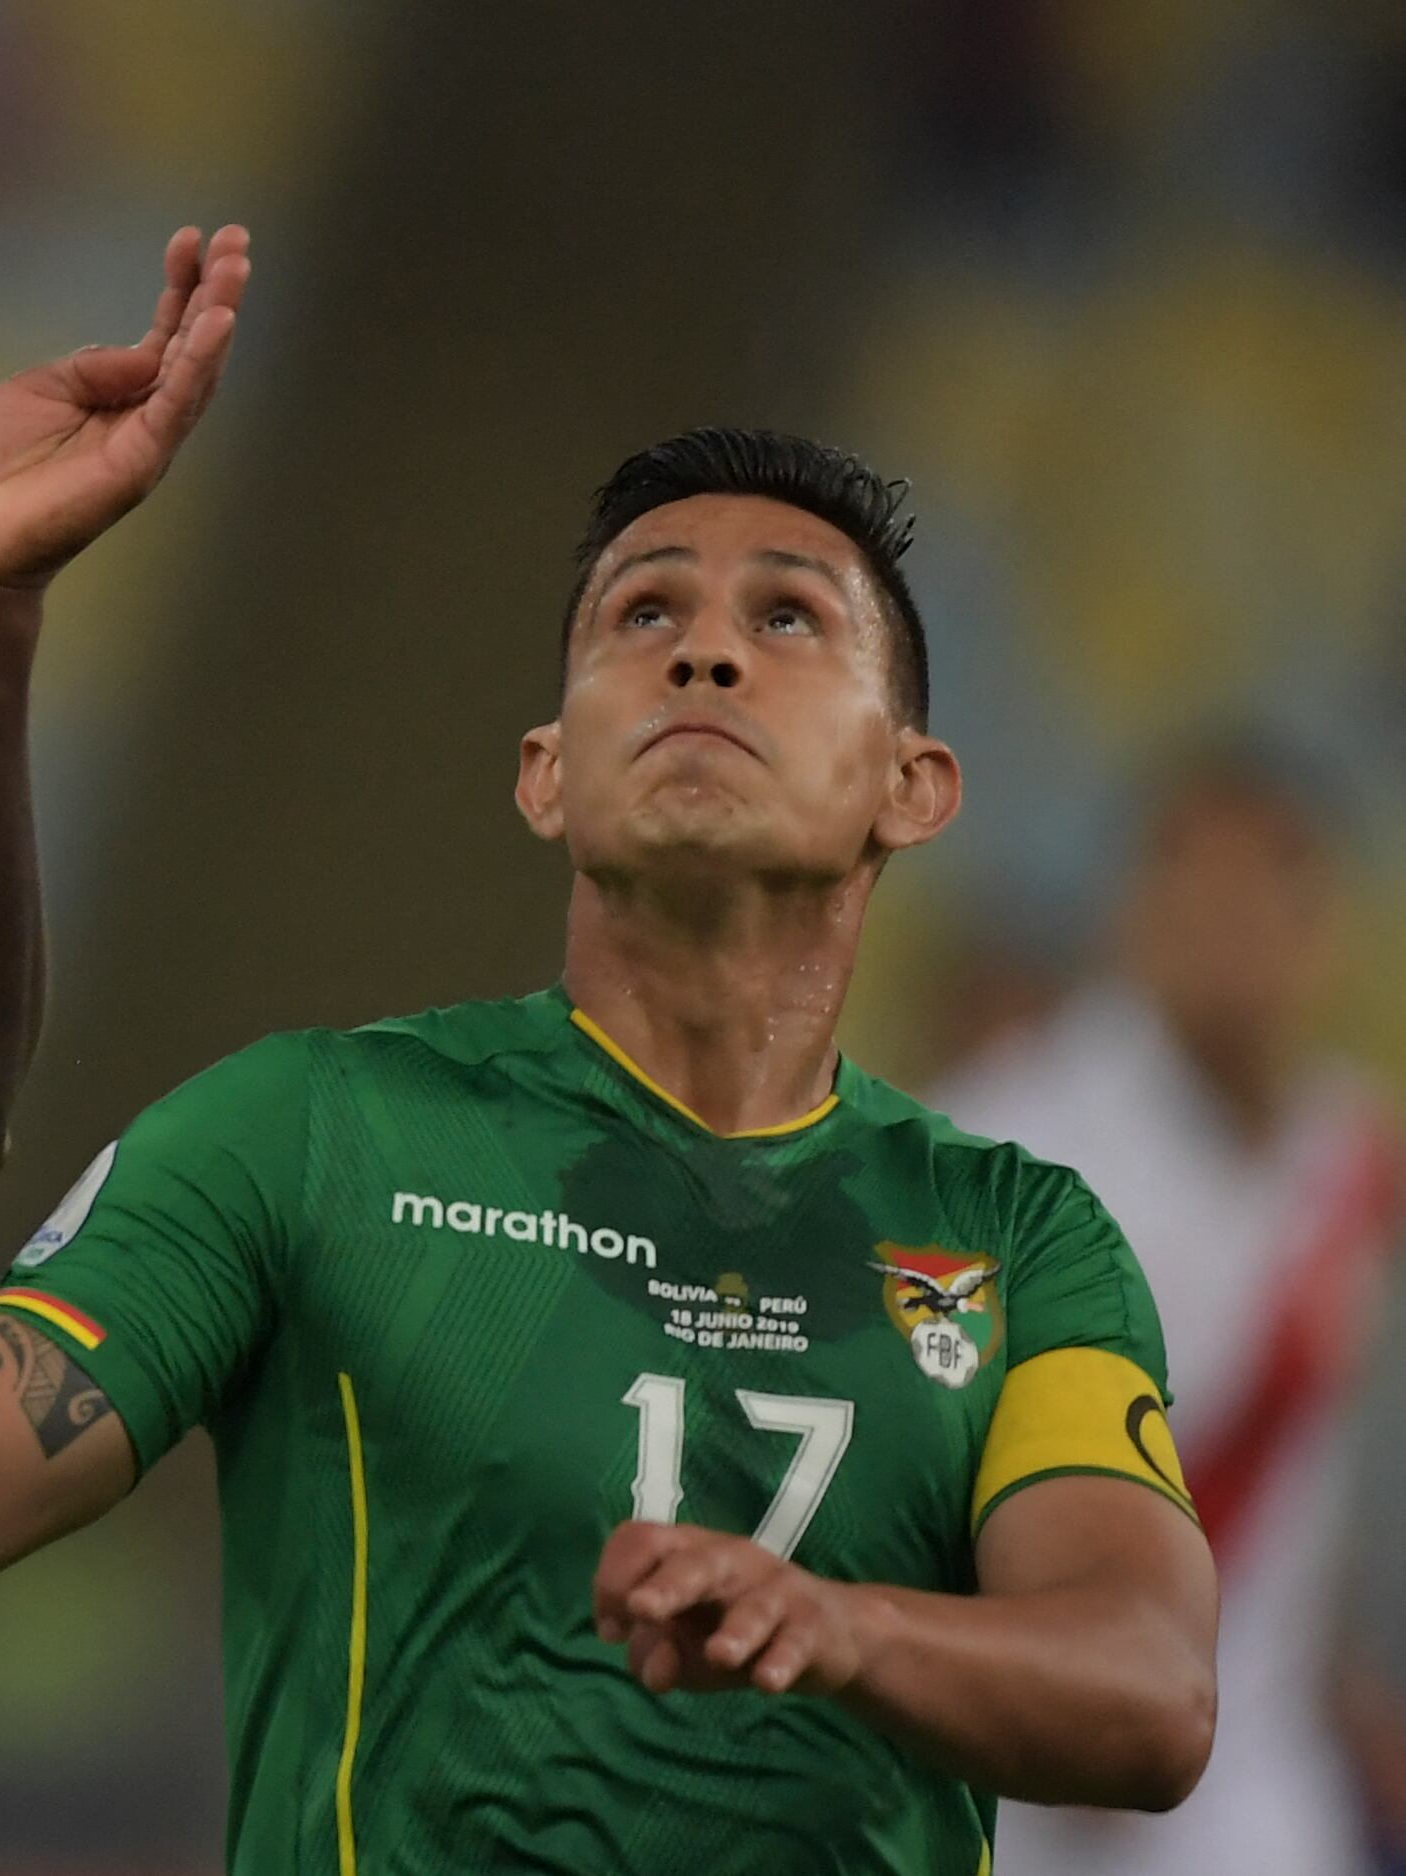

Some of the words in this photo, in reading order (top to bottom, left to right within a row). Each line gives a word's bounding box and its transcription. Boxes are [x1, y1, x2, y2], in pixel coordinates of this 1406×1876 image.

[392, 1191, 657, 1269] marathon
[648, 1279, 718, 1303] BOLIVIA
[759, 1295, 808, 1314] PERÚ
[670, 1309, 693, 1327] 18
[695, 1312, 754, 1329] JUNIO
[697, 1330, 725, 1348] DE
[726, 1333, 809, 1352] JANEIRO
[621, 1372, 855, 1562] 17
